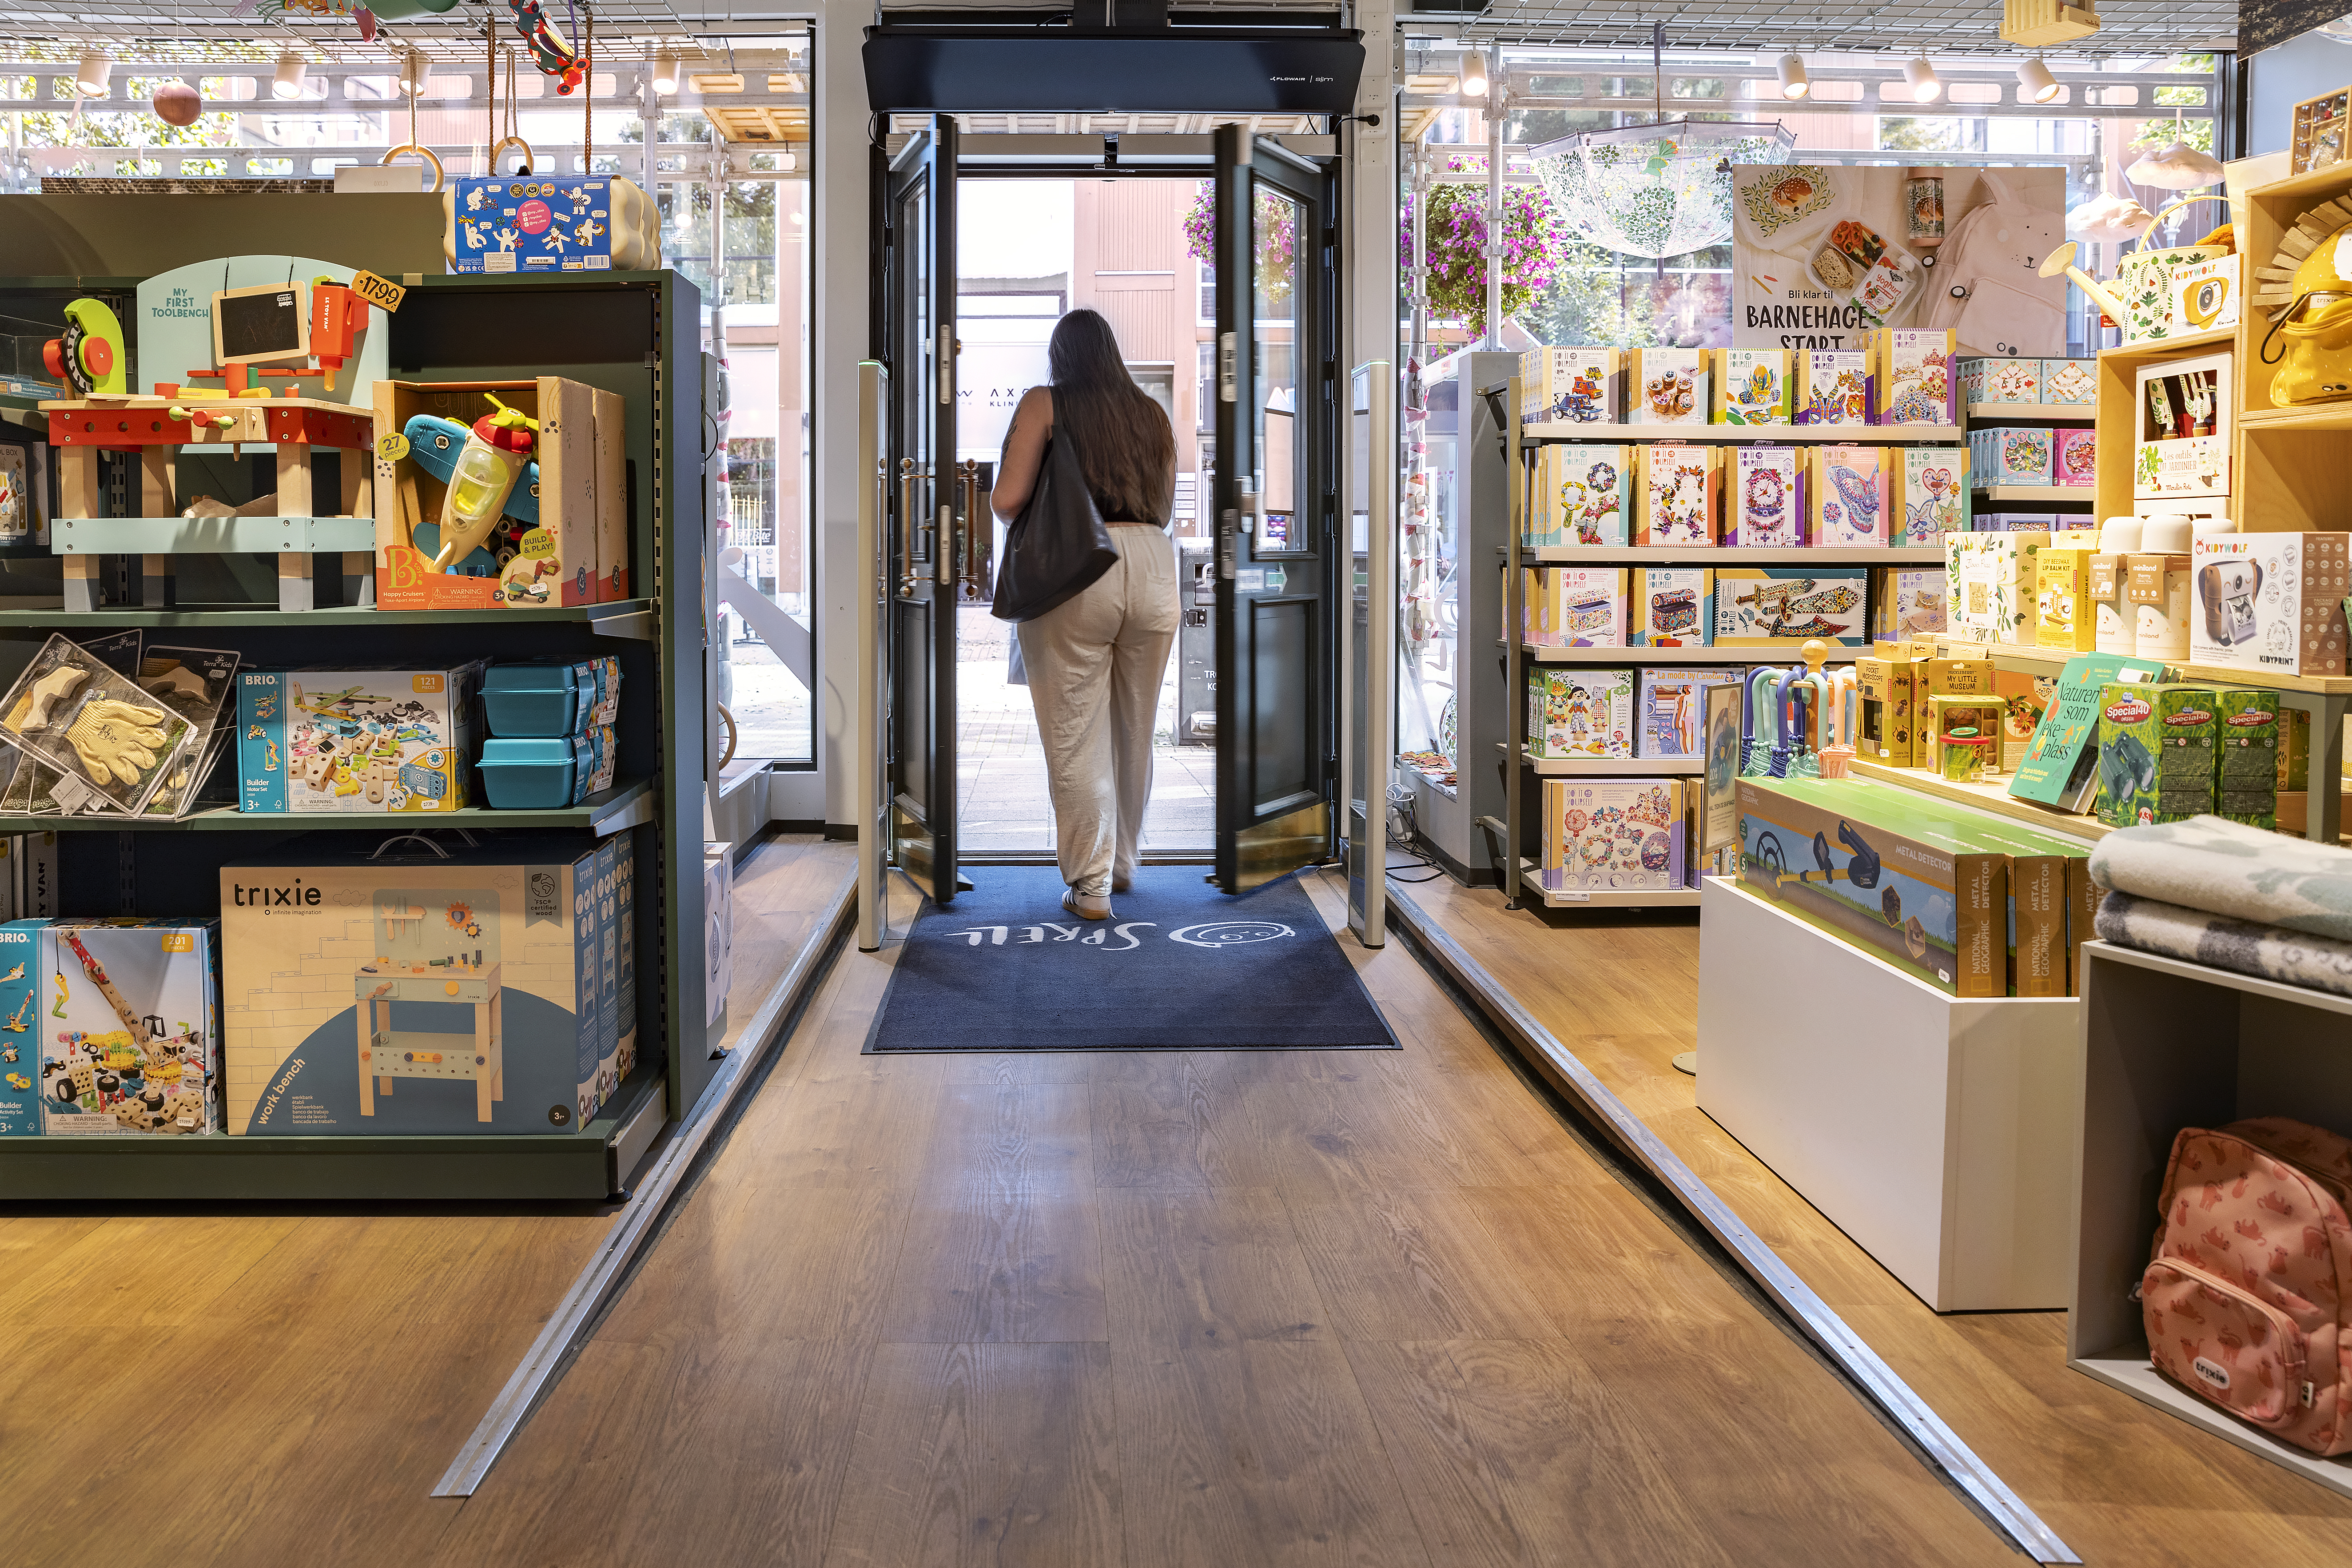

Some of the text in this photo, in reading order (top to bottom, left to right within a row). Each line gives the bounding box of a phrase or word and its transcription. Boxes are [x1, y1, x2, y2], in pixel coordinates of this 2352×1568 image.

[2176, 264, 2216, 281] KIDYWOLF
[1876, 274, 1902, 297] Yoghurt
[1788, 290, 1833, 299] Bli klar til
[167, 297, 194, 307] FIRST
[152, 308, 208, 317] TOOLBENCH
[1747, 305, 1877, 330] BARNEHAGE-
[1780, 335, 1845, 349] START
[383, 435, 400, 451] 27
[384, 446, 407, 458] pieces!
[2165, 450, 2192, 460] Les outils
[2160, 461, 2197, 471] DU JARDINIER
[525, 536, 546, 545] BUILD
[532, 543, 553, 552] PLAY!
[2205, 543, 2248, 553] KIDYWOLF
[414, 562, 423, 577] toys
[44, 642, 65, 670] Terra Kids
[2259, 655, 2293, 665] KIDYPRINT
[246, 676, 275, 685] BRIO
[1204, 670, 1217, 679] TR
[1688, 671, 1695, 681] by
[1696, 671, 1725, 680] Caroline
[1862, 673, 1883, 682] MICROSCOPE
[2060, 683, 2100, 703] Naturen
[2064, 705, 2089, 721] som
[2107, 705, 2149, 718] Special40
[2166, 712, 2210, 725] Special40
[2039, 718, 2065, 737] leke-
[2040, 739, 2071, 761] plass
[5, 799, 28, 808] HABA
[247, 800, 259, 810] 3+
[1895, 844, 1952, 872] METAL DETECTOR
[235, 878, 321, 906] trixie
[944, 922, 1156, 951] SPRELL
[1981, 919, 1990, 974] GEOGRAPHIC
[258, 1059, 306, 1124] work bench
[0, 1122, 13, 1132] 3+
[2196, 1360, 2227, 1384] trixie
